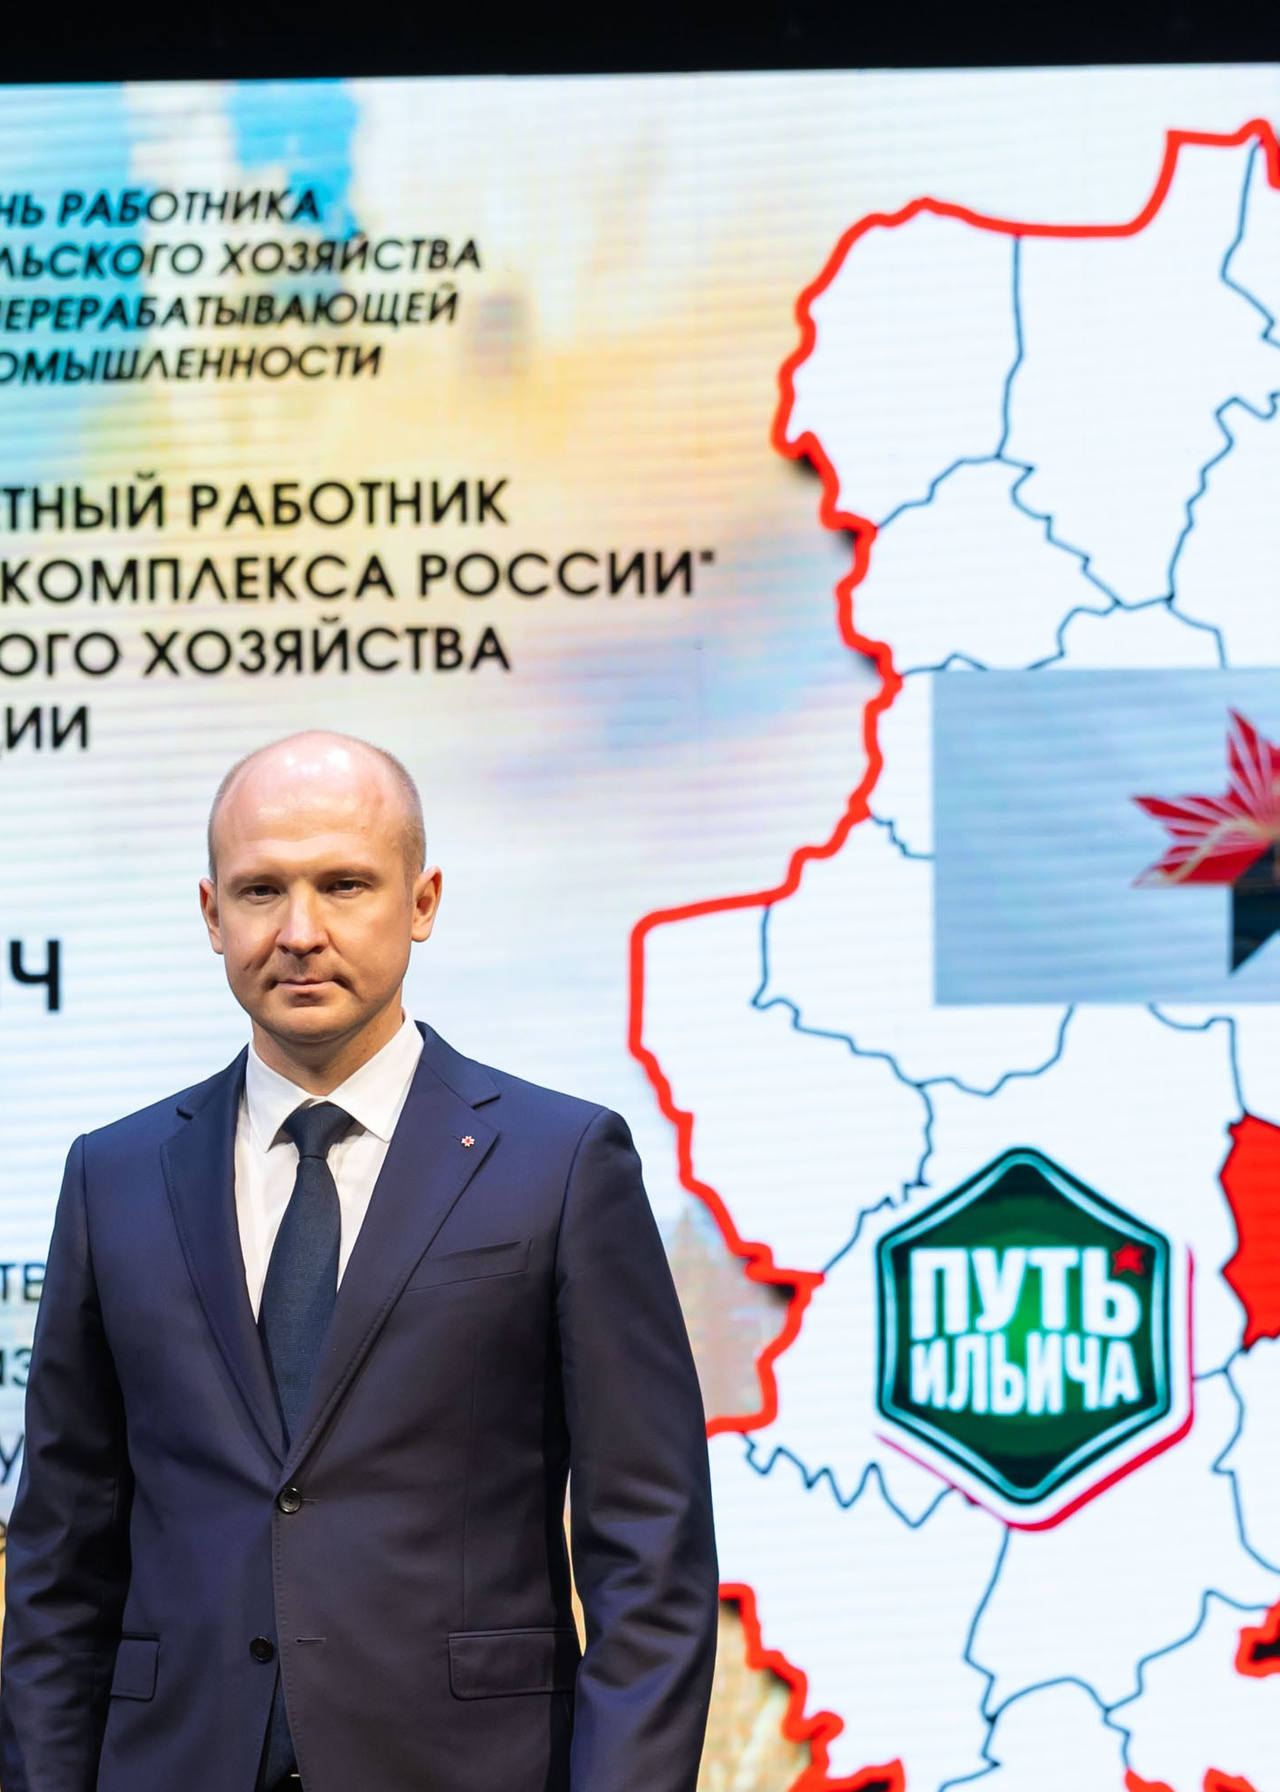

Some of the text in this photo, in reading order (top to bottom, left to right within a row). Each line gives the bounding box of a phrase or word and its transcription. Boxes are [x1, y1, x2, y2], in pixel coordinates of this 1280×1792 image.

[57, 188, 321, 227] РАБОТНИКА
[219, 231, 482, 277] ХОЗЯЙСТВА
[189, 478, 508, 530] РАБОТНИК
[0, 553, 396, 606] КОМПЛЕКСА
[418, 549, 715, 600] РОССИИ"
[142, 616, 511, 678] ХОЗЯЙСТВА
[908, 1245, 1142, 1341] ПУТЬ
[908, 1331, 1142, 1415] ИЛЬИЧА
